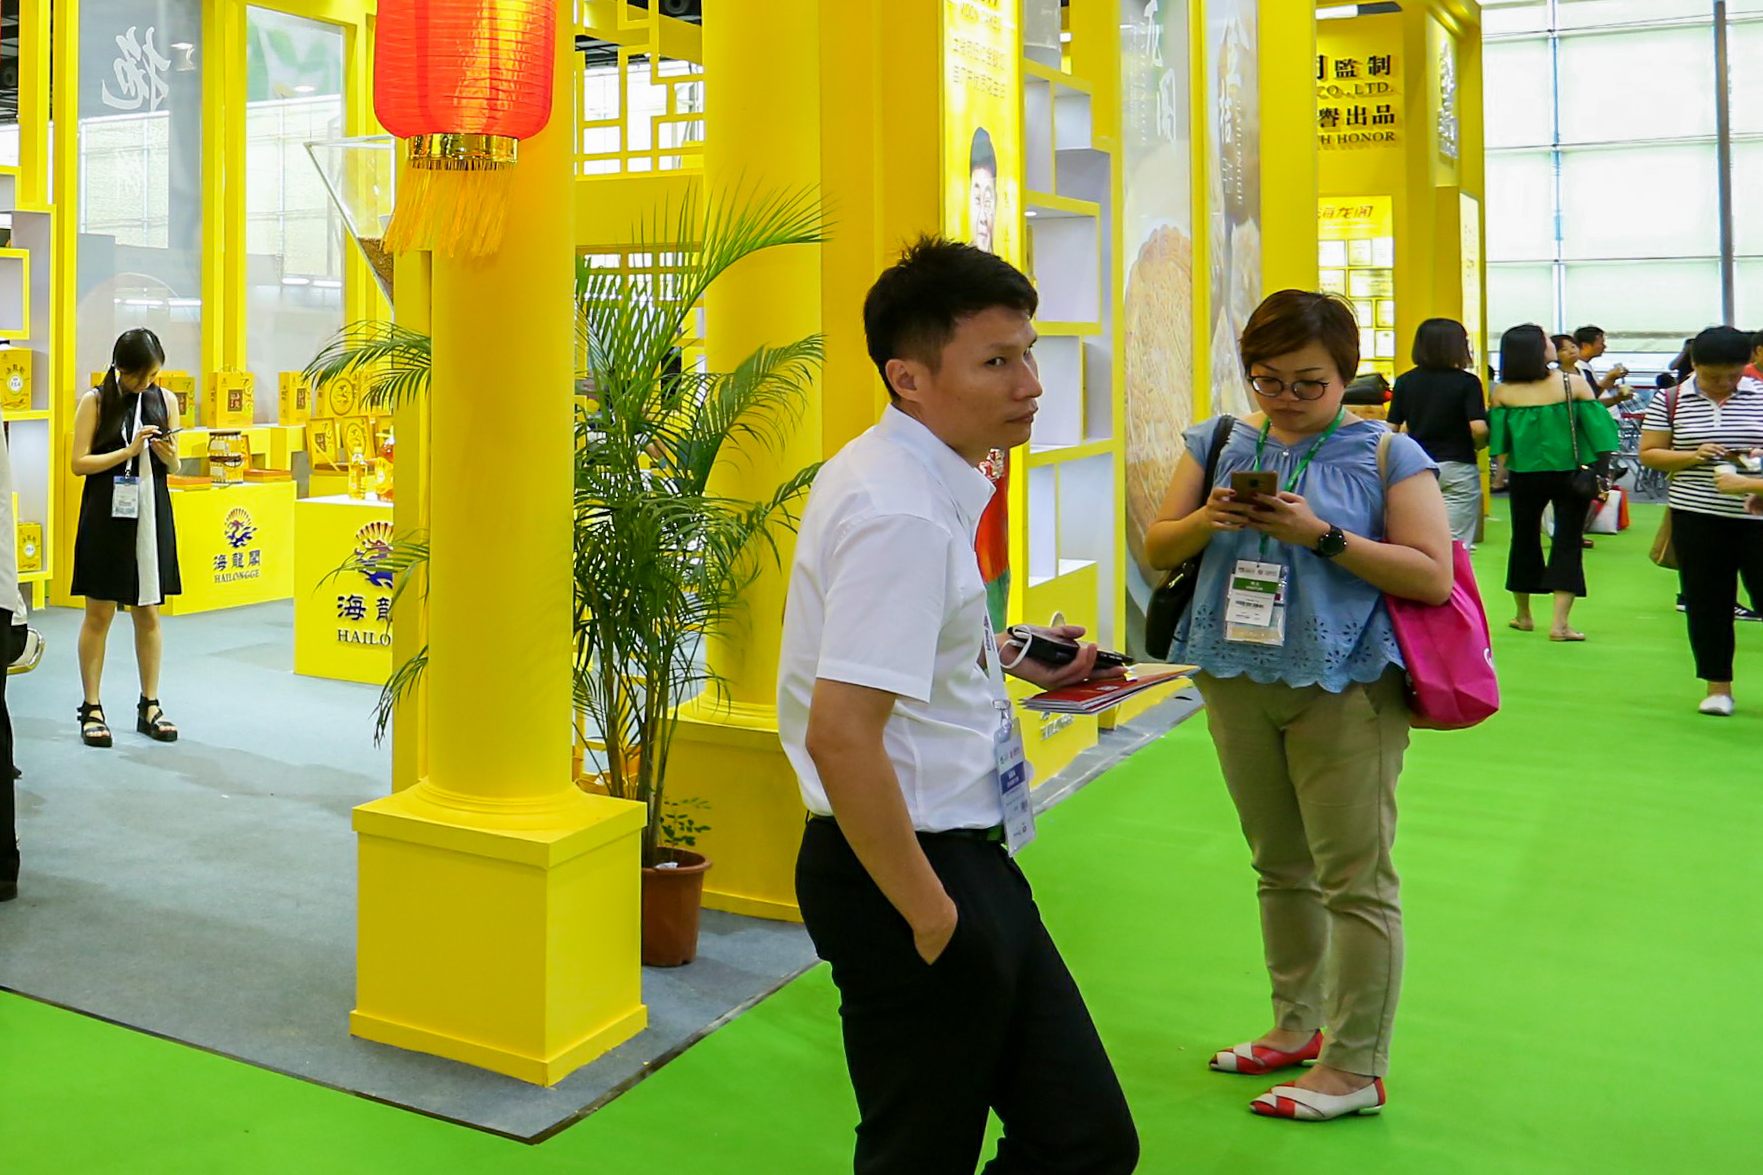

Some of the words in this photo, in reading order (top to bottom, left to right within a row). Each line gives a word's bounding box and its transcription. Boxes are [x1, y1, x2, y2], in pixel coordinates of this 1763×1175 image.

[1337, 131, 1395, 144] HONOR
[213, 550, 260, 571] 海龍閣
[214, 569, 260, 583] HAILONGGE
